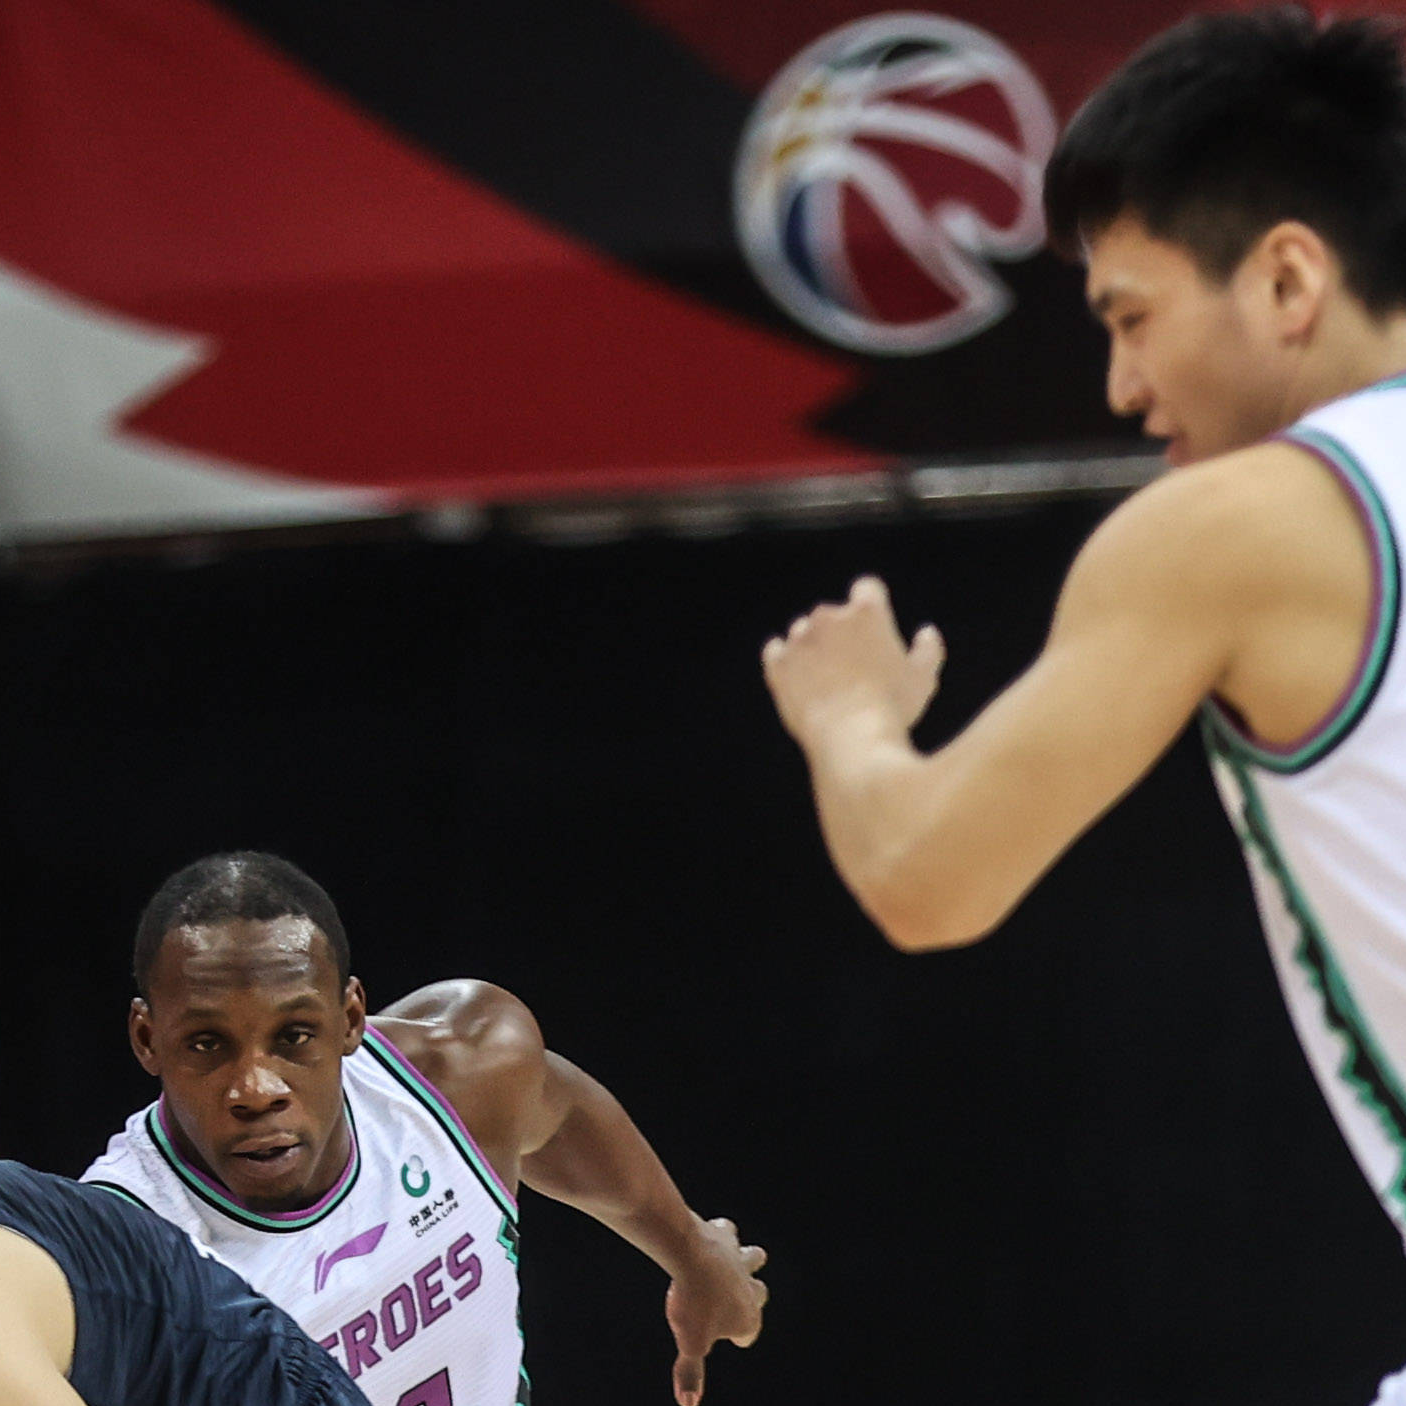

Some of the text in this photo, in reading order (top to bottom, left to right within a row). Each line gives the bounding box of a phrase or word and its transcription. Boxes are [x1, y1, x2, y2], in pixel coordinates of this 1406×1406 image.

[415, 1201, 459, 1238] CHINA LIFE
[317, 1232, 482, 1380] ROES
